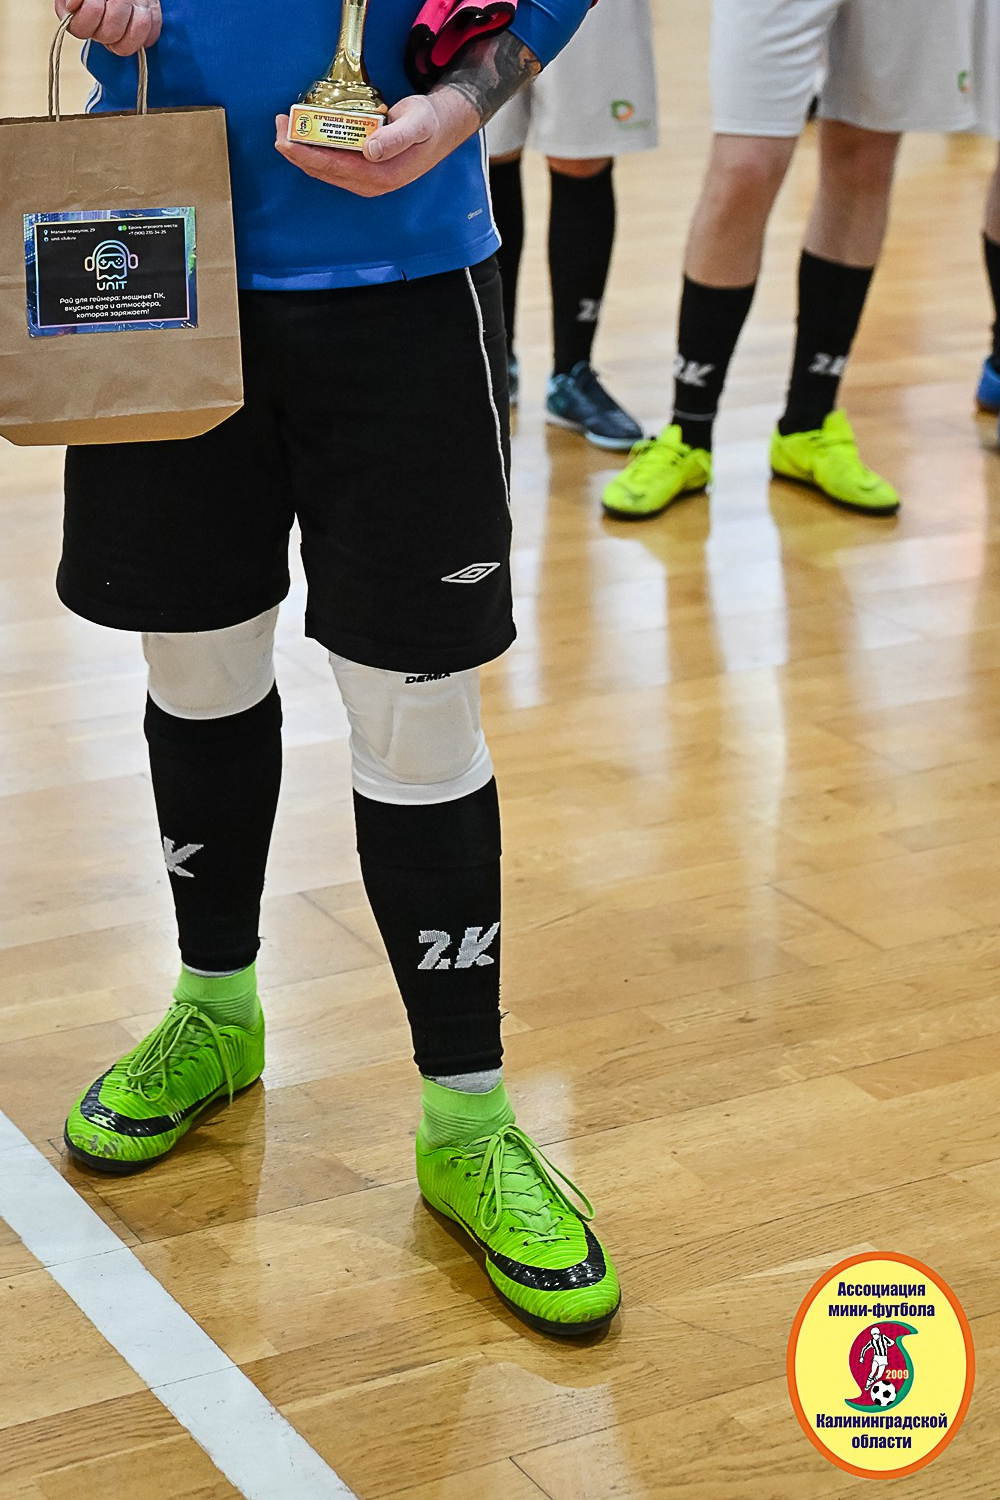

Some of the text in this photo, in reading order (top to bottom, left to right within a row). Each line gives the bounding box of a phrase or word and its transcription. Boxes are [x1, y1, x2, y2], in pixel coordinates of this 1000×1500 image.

[96, 280, 127, 291] UNIT
[59, 297, 74, 305] Рай
[75, 297, 88, 305] для
[89, 295, 121, 304] геймера:
[122, 294, 152, 302] мощные
[64, 305, 94, 313] вкусная
[95, 304, 109, 312] еда
[76, 308, 150, 320] которая заряжает!
[577, 299, 600, 322] 2
[417, 922, 500, 970] 2K
